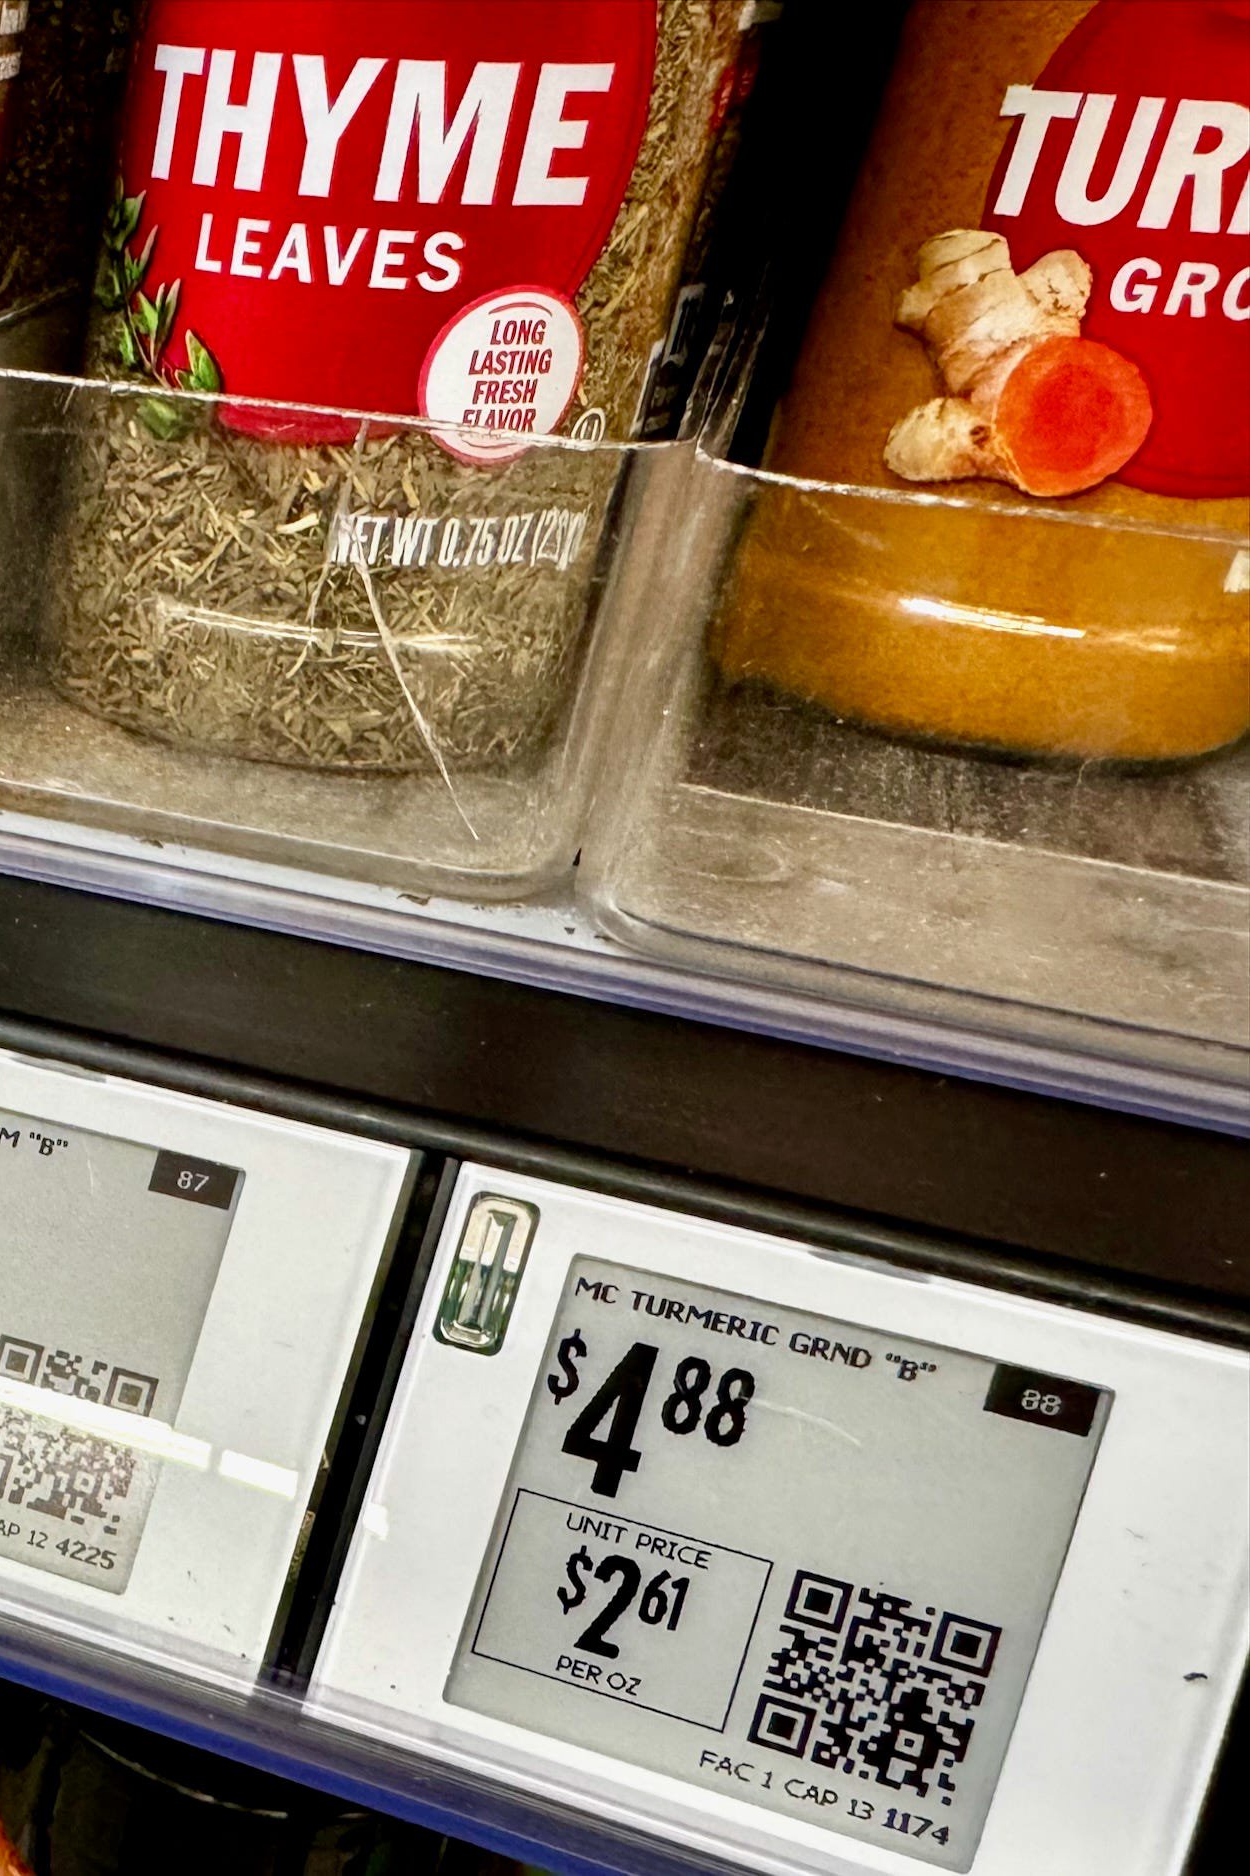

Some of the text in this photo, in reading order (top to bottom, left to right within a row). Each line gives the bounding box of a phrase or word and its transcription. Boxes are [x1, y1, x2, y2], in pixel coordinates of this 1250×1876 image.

[151, 44, 616, 206] THYME
[993, 84, 1250, 234] TUR
[194, 213, 466, 293] LEAVES
[490, 320, 547, 346] LONG
[468, 349, 553, 376] LASTING
[472, 379, 538, 405] FRESH
[390, 514, 441, 567] WT
[438, 513, 500, 568] 0.75
[497, 511, 534, 564] OZ
[176, 1170, 211, 1194] 87
[574, 1276, 621, 1304] MC
[631, 1289, 781, 1346] TURMERIC
[788, 1332, 873, 1370] GRND
[1021, 1388, 1062, 1416] 88
[26, 1529, 49, 1549] 12
[55, 1537, 118, 1571] 4225
[566, 1512, 713, 1570] UNIT PRICE
[555, 1654, 642, 1697] PER OZ
[699, 1749, 950, 1846] FAC 1 CAP 13 1174
